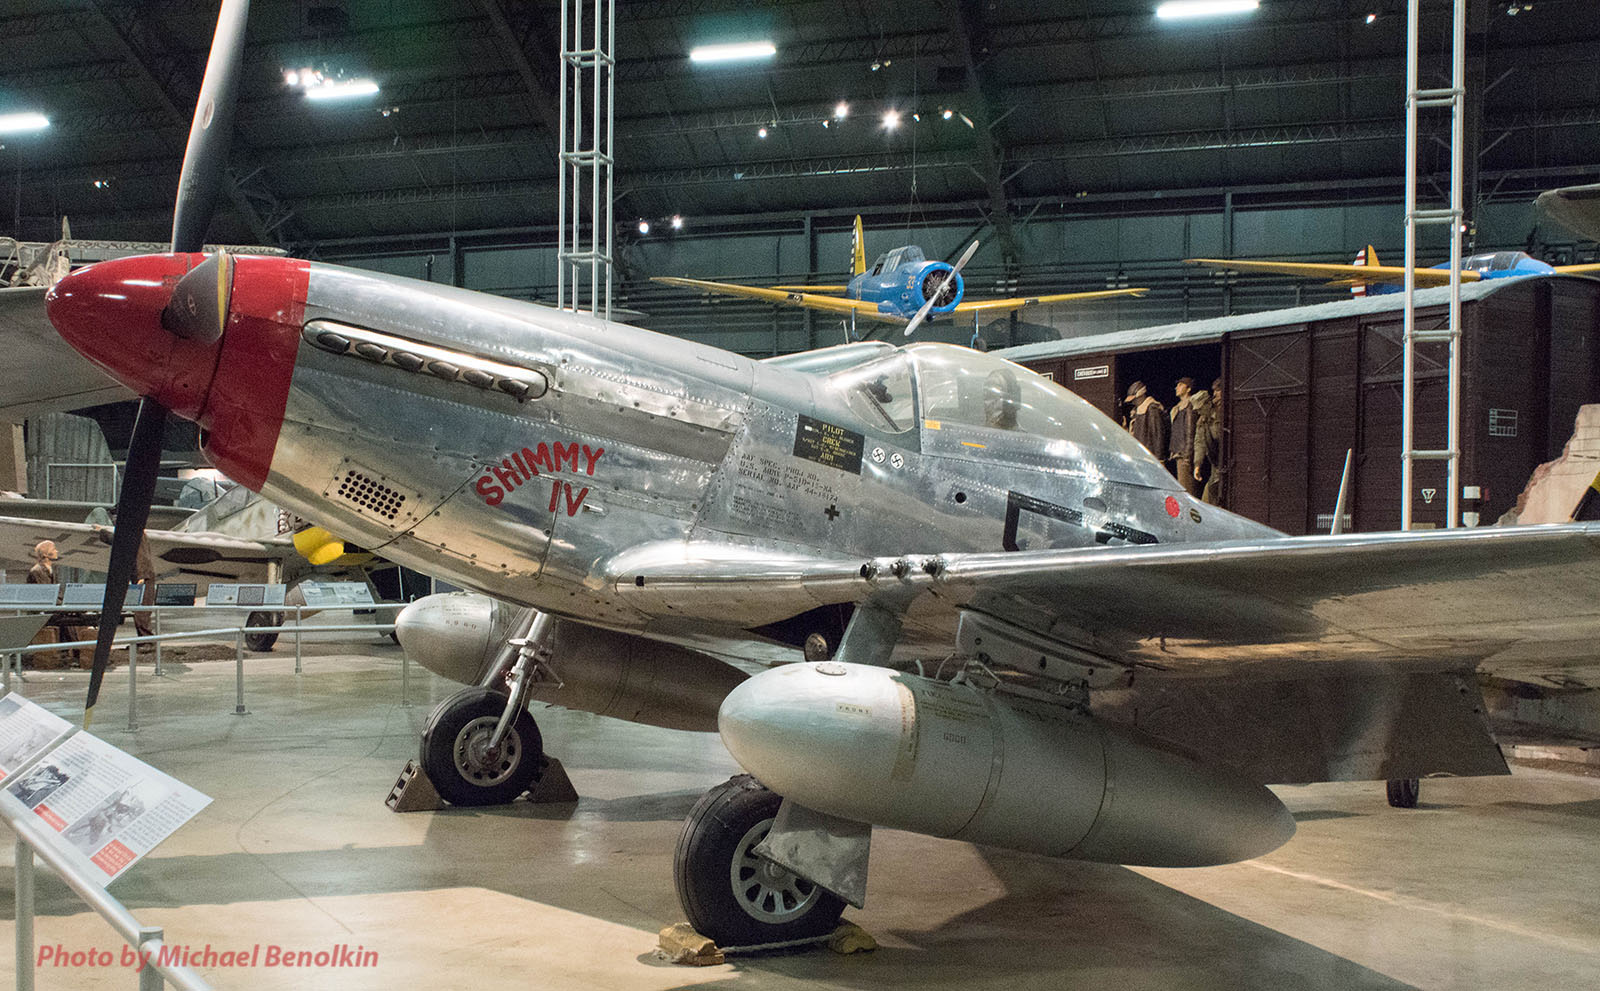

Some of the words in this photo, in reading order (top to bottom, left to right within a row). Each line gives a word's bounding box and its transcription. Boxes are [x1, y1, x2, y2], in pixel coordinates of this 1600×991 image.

[822, 424, 845, 435] PILOT
[822, 436, 841, 447] CREW
[740, 460, 757, 470] U.S.
[763, 467, 780, 476] ARMY
[742, 453, 755, 461] AAF
[760, 458, 780, 470] SPEC.
[476, 441, 604, 505] SHIMMY
[738, 467, 765, 481] SERIAL
[770, 478, 782, 486] NO.
[787, 482, 800, 490] AAF
[549, 480, 589, 517] IV
